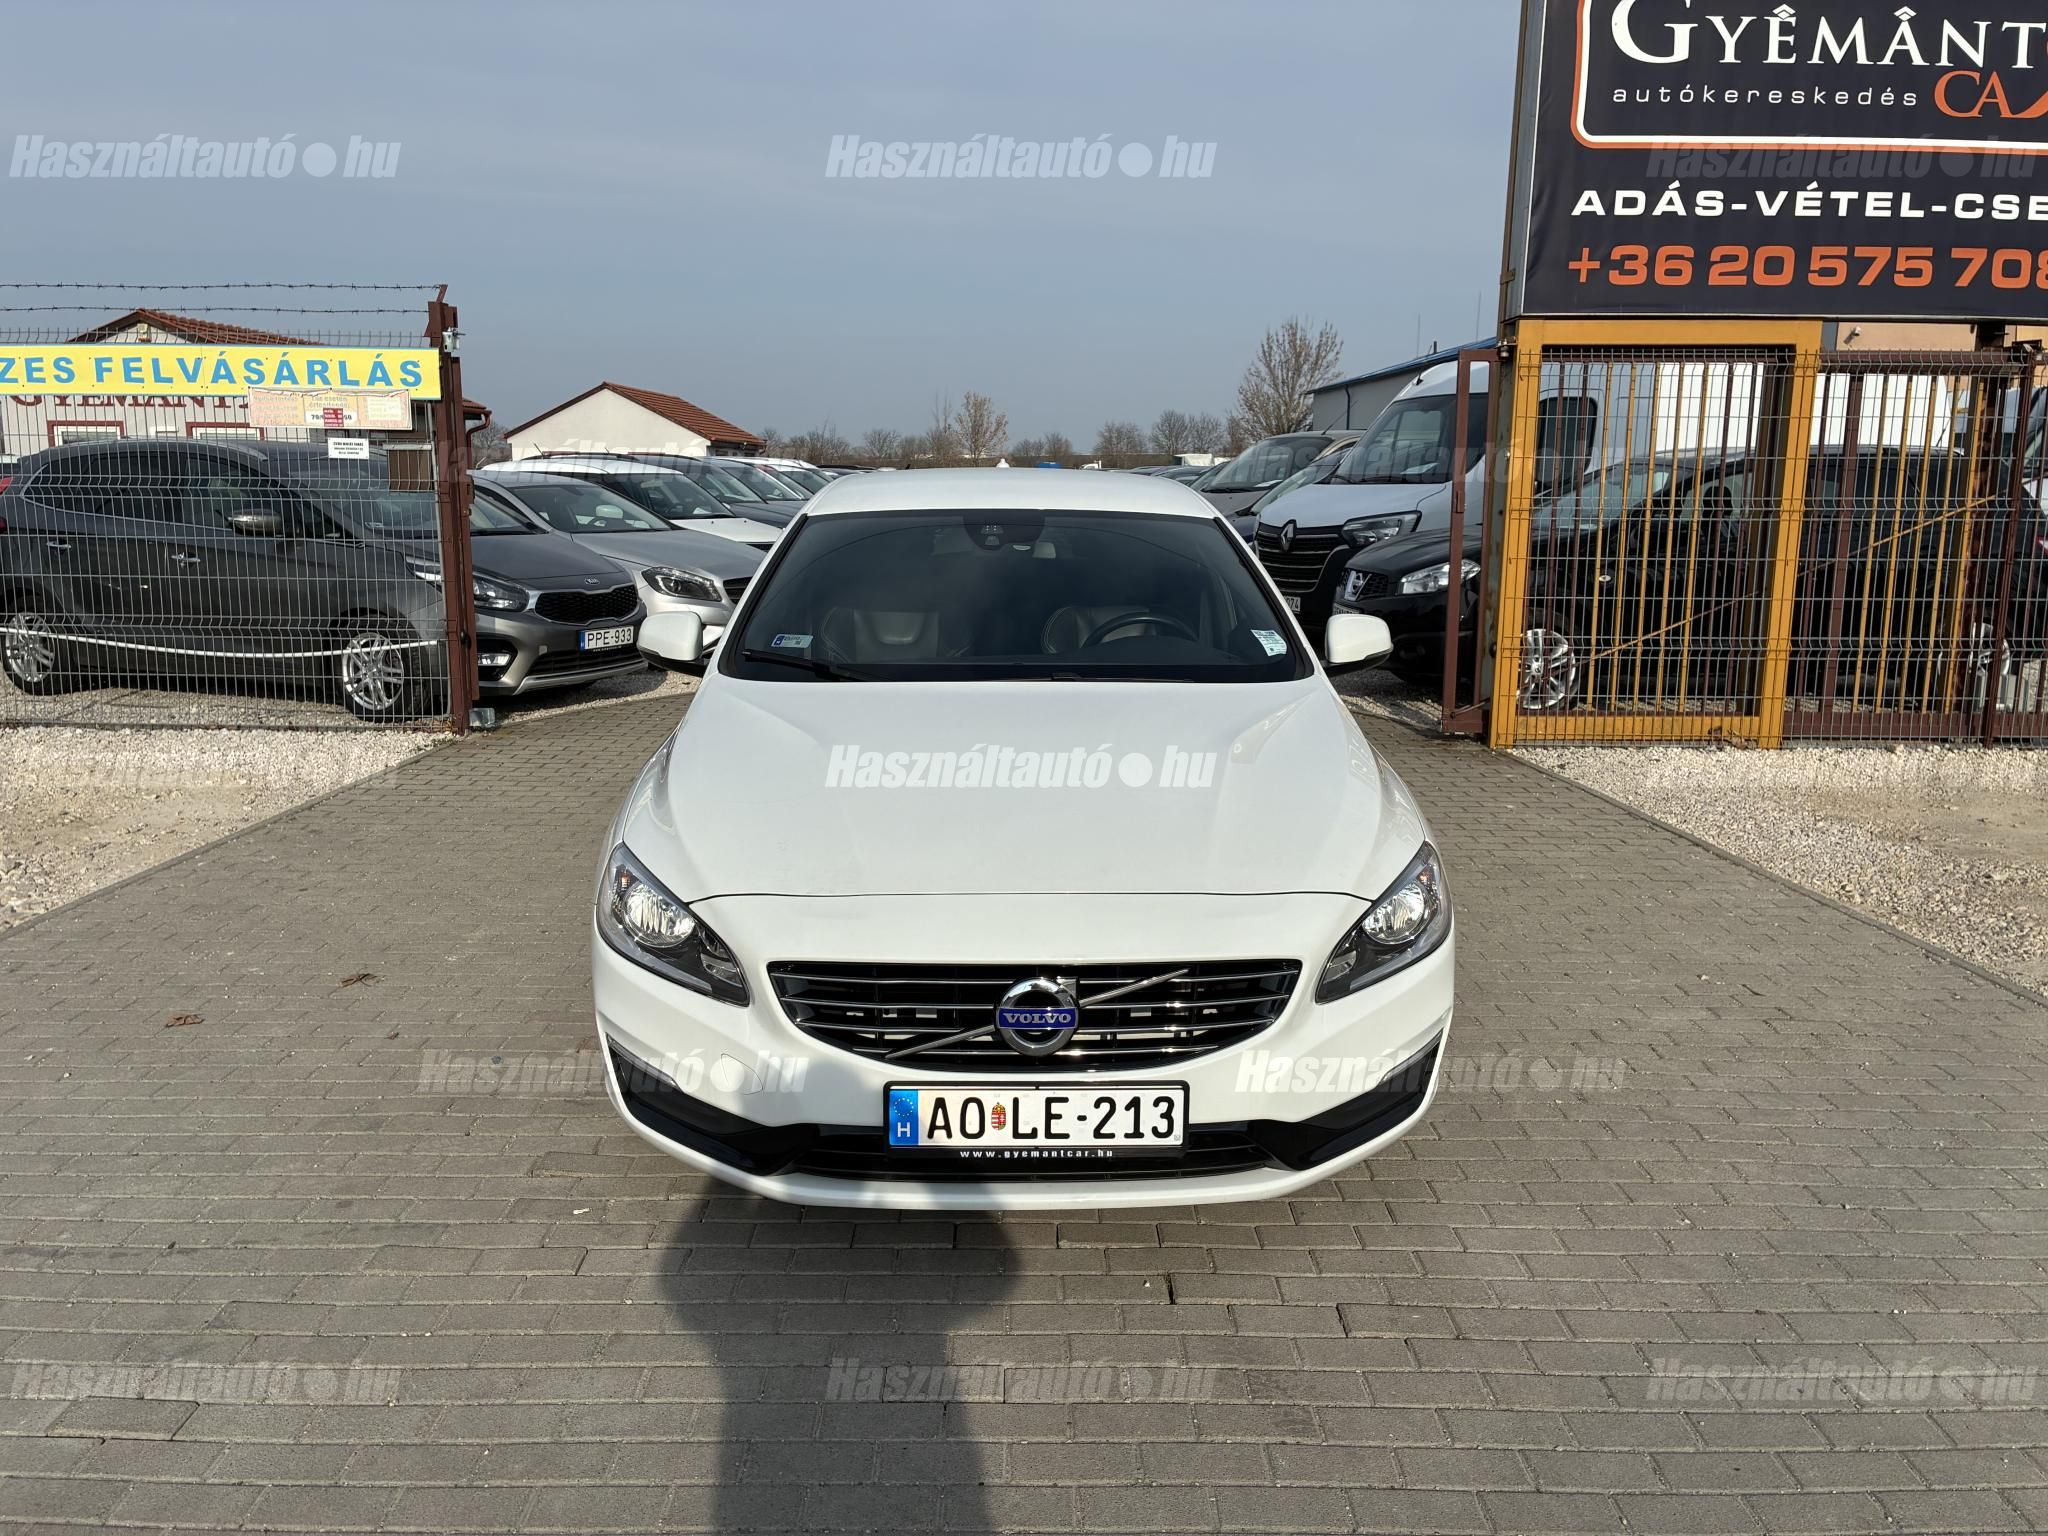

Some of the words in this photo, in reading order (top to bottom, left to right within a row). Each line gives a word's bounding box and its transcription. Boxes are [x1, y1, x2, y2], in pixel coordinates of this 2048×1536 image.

[1613, 84, 1917, 106] autókereskedés
[1934, 70, 2048, 119] CA
[1568, 246, 1694, 286] +36
[1708, 246, 1797, 286] 20
[1807, 246, 1933, 287] 575
[94, 351, 423, 387] FELVÁSÁRLÁS
[588, 629, 631, 647] PPE-933
[1003, 1013, 1072, 1024] VOLVO
[927, 1097, 985, 1139] AO
[1012, 1096, 1175, 1139] LE-213
[897, 1122, 910, 1137] H
[960, 1149, 1113, 1158] www.gyemantcar.hu
